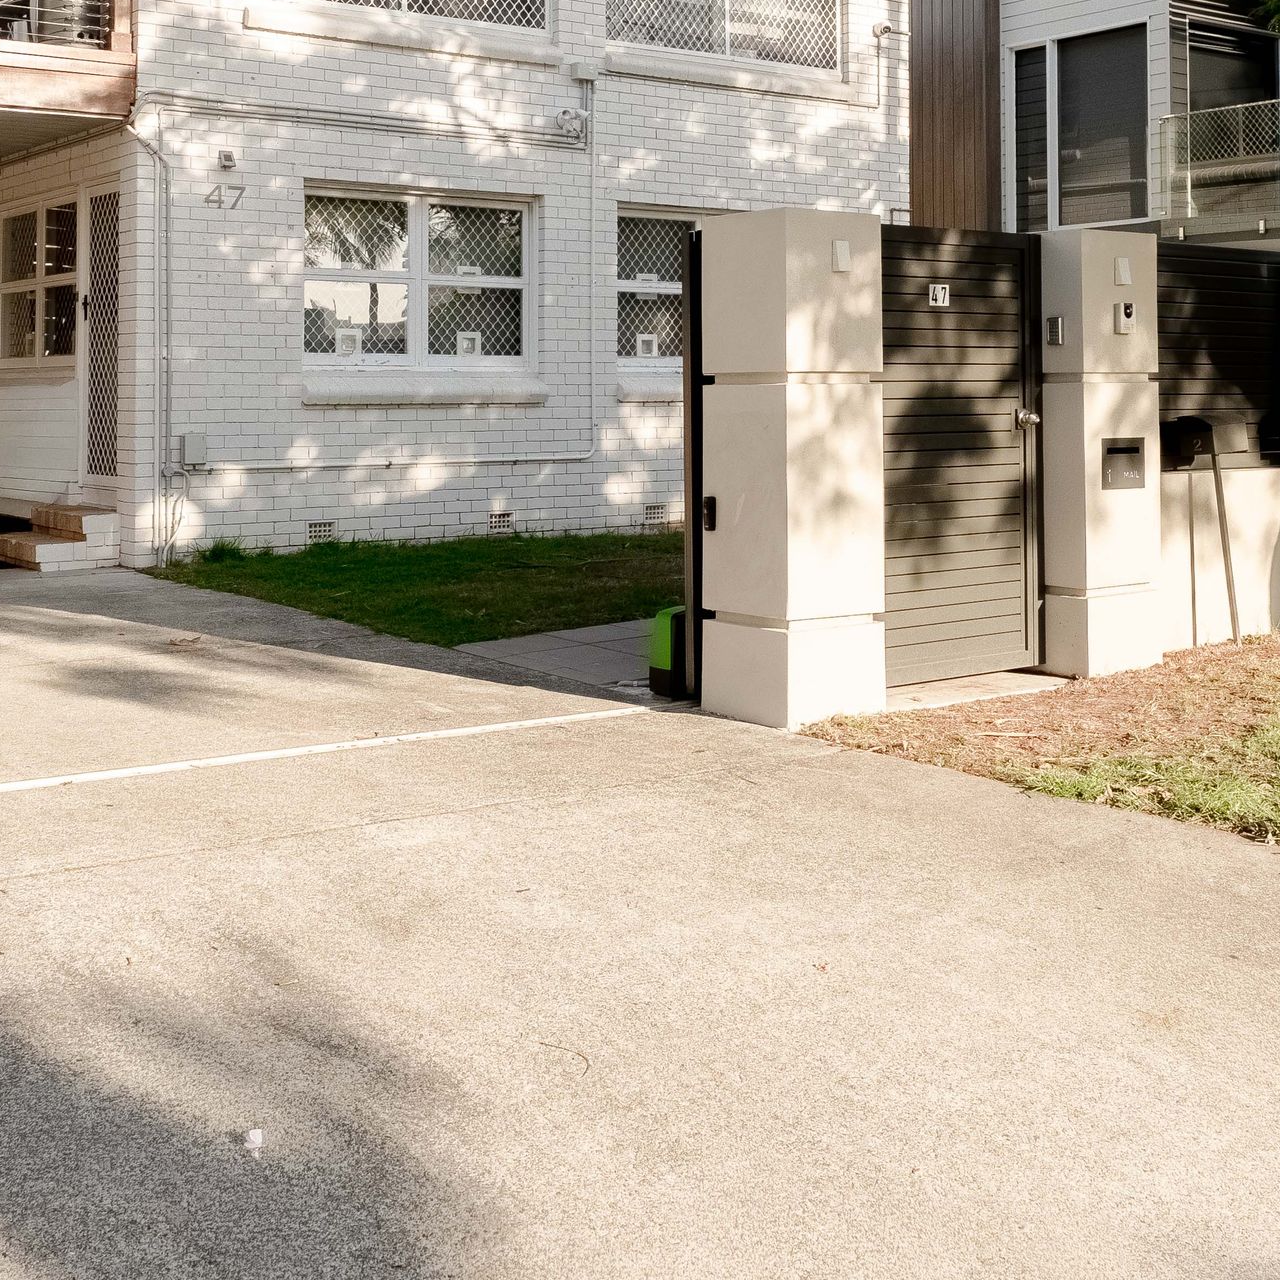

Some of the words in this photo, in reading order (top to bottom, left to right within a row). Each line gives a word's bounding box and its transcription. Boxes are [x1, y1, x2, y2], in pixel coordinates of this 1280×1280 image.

[204, 184, 246, 210] 47
[931, 286, 947, 304] 47
[1193, 439, 1202, 451] 2
[1123, 470, 1140, 479] MAIL
